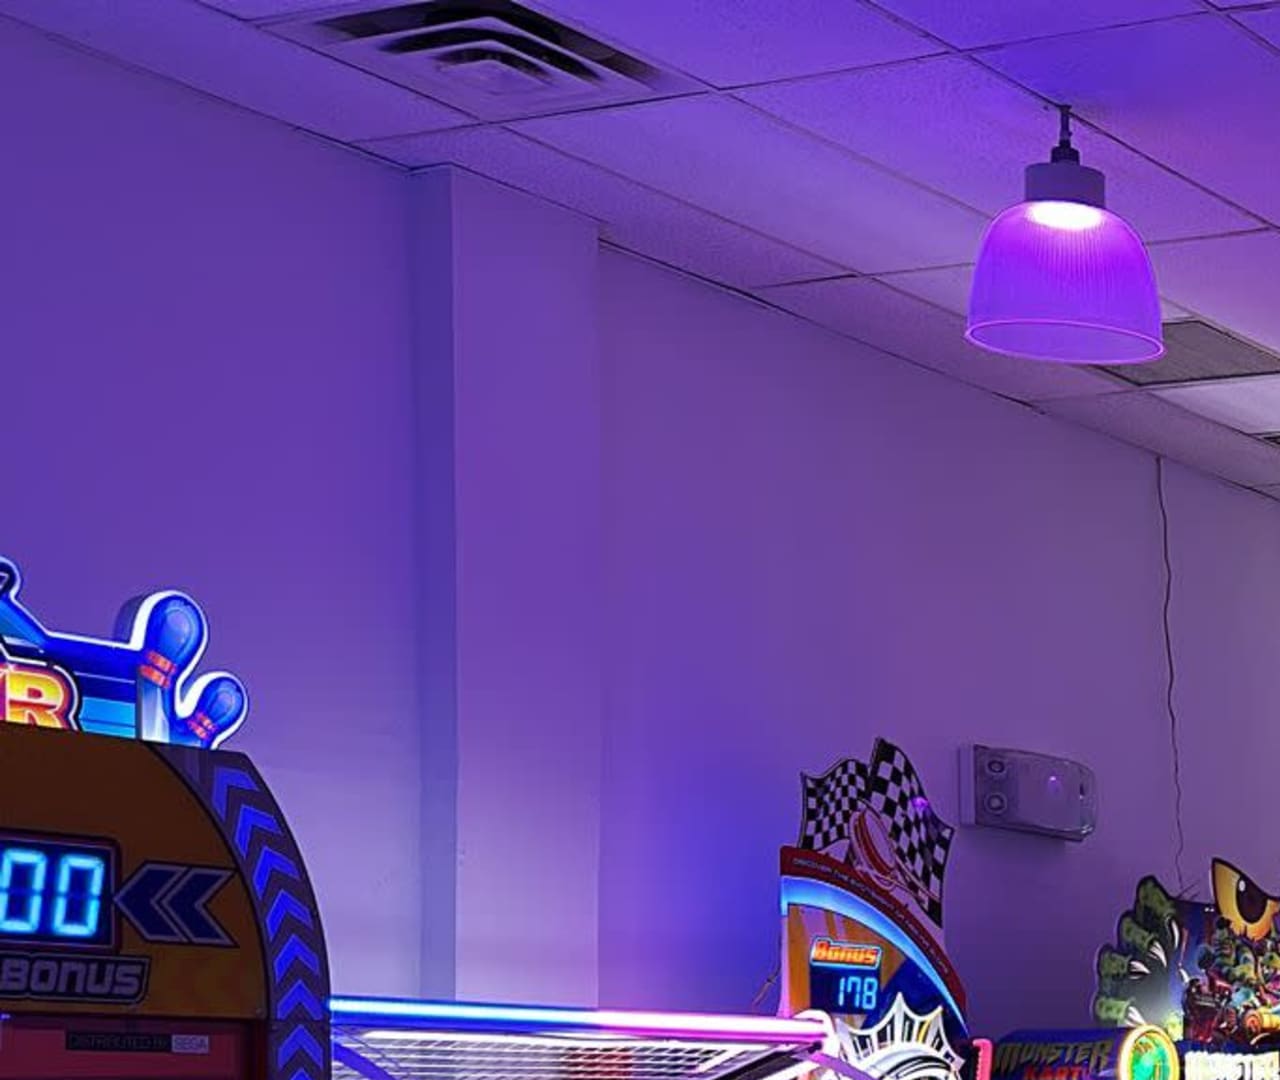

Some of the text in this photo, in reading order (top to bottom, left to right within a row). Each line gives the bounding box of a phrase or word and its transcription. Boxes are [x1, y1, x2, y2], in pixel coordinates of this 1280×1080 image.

[0, 664, 68, 728] R
[838, 977, 878, 1010] 178
[994, 1040, 1112, 1073] MONSTER
